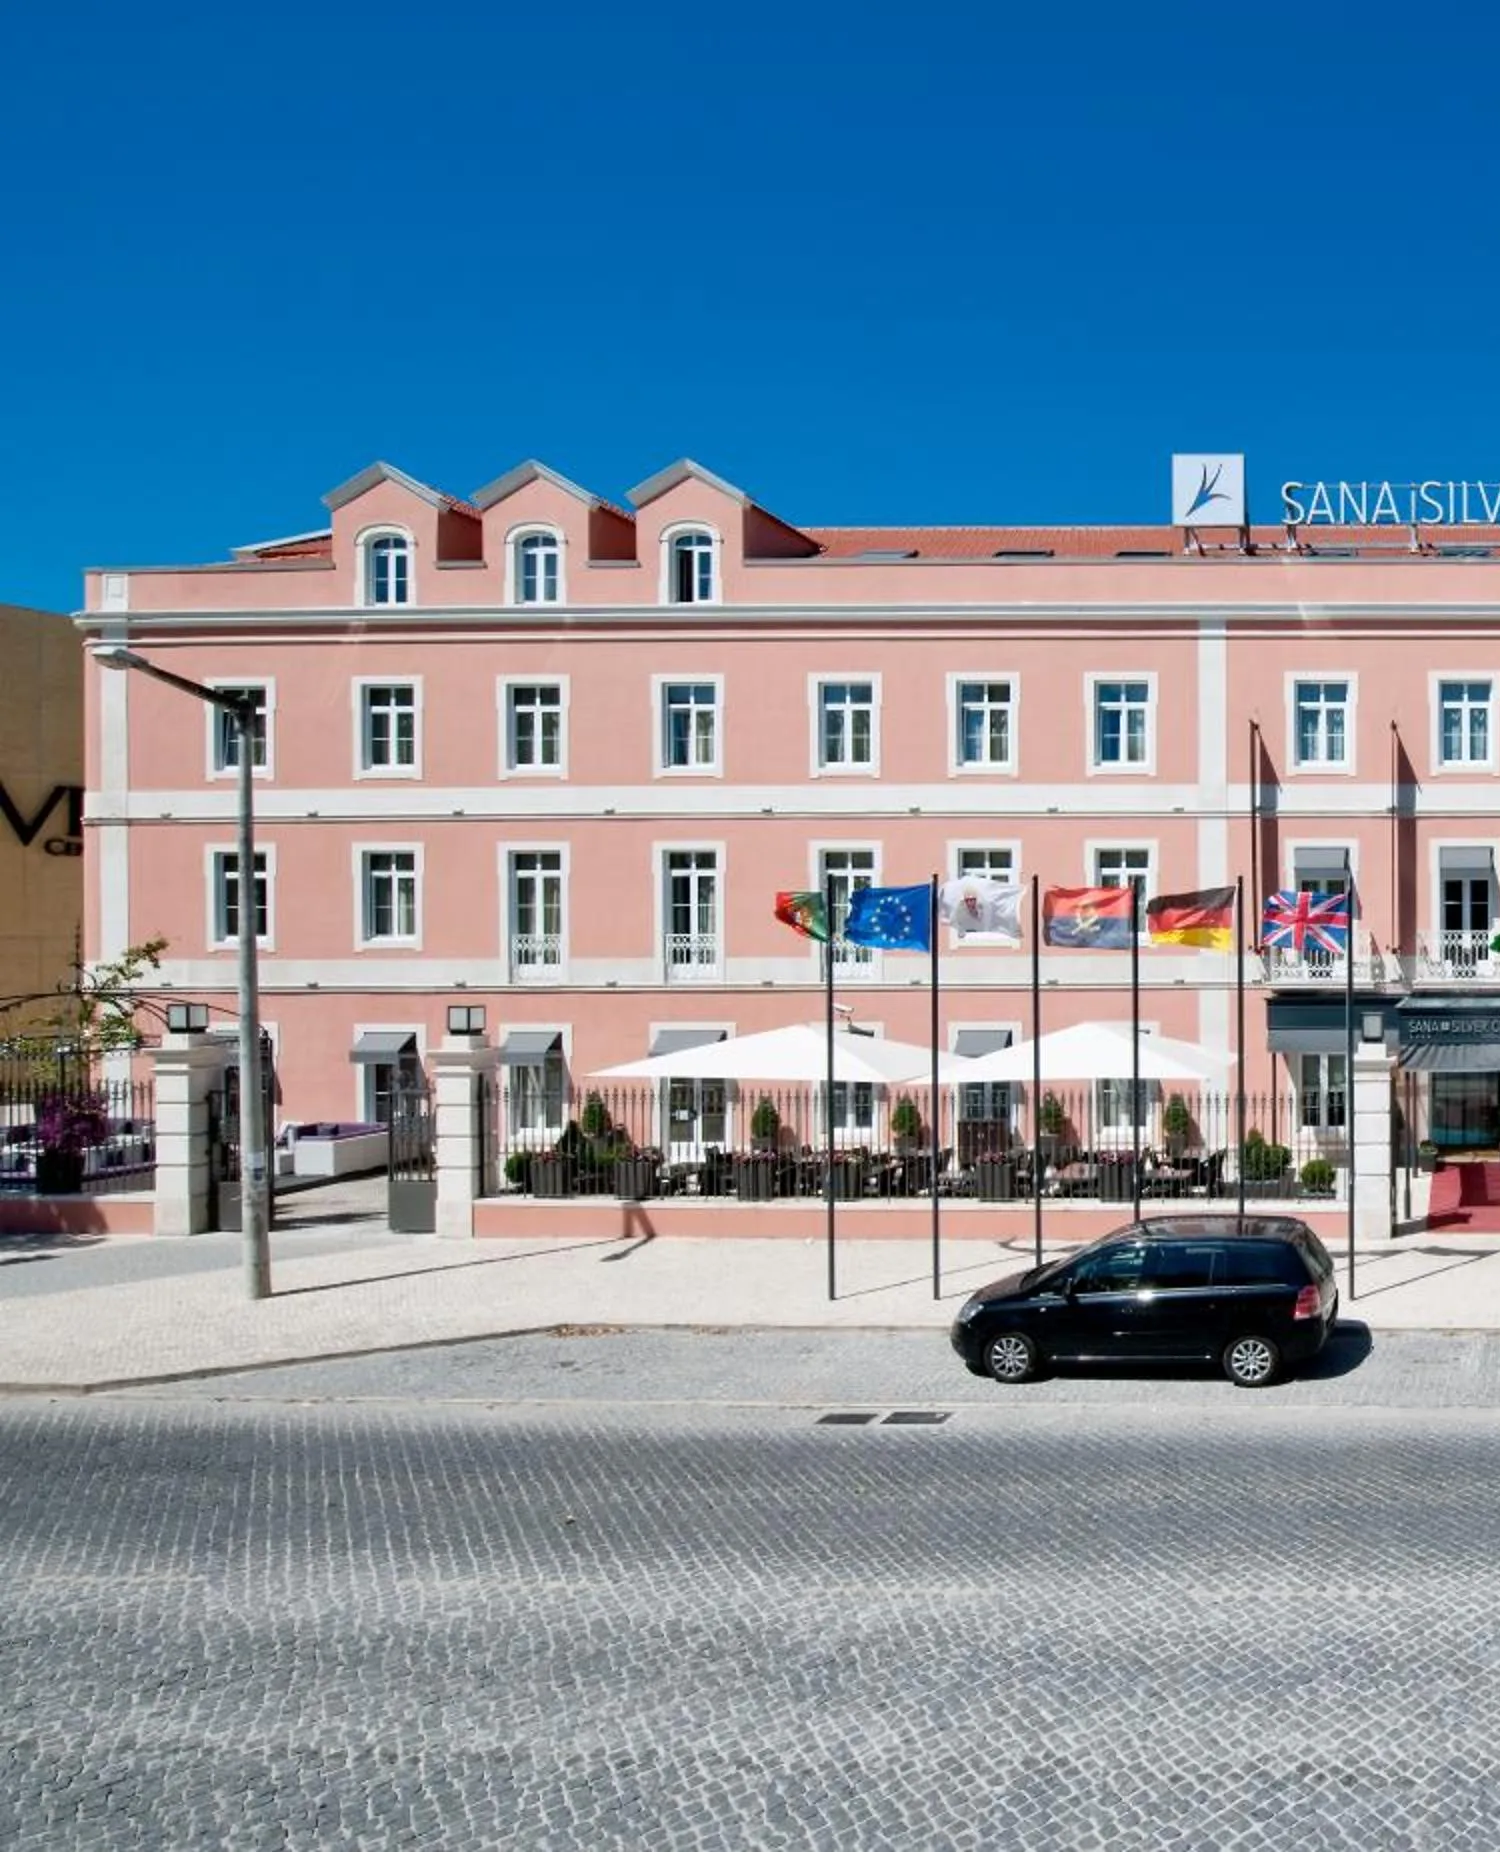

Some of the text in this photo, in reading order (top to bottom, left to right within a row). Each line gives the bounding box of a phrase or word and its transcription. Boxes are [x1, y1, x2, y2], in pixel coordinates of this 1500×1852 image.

[1281, 480, 1401, 525] SANA
[1408, 1019, 1440, 1034] SANA
[1451, 1019, 1490, 1034] SILVER
